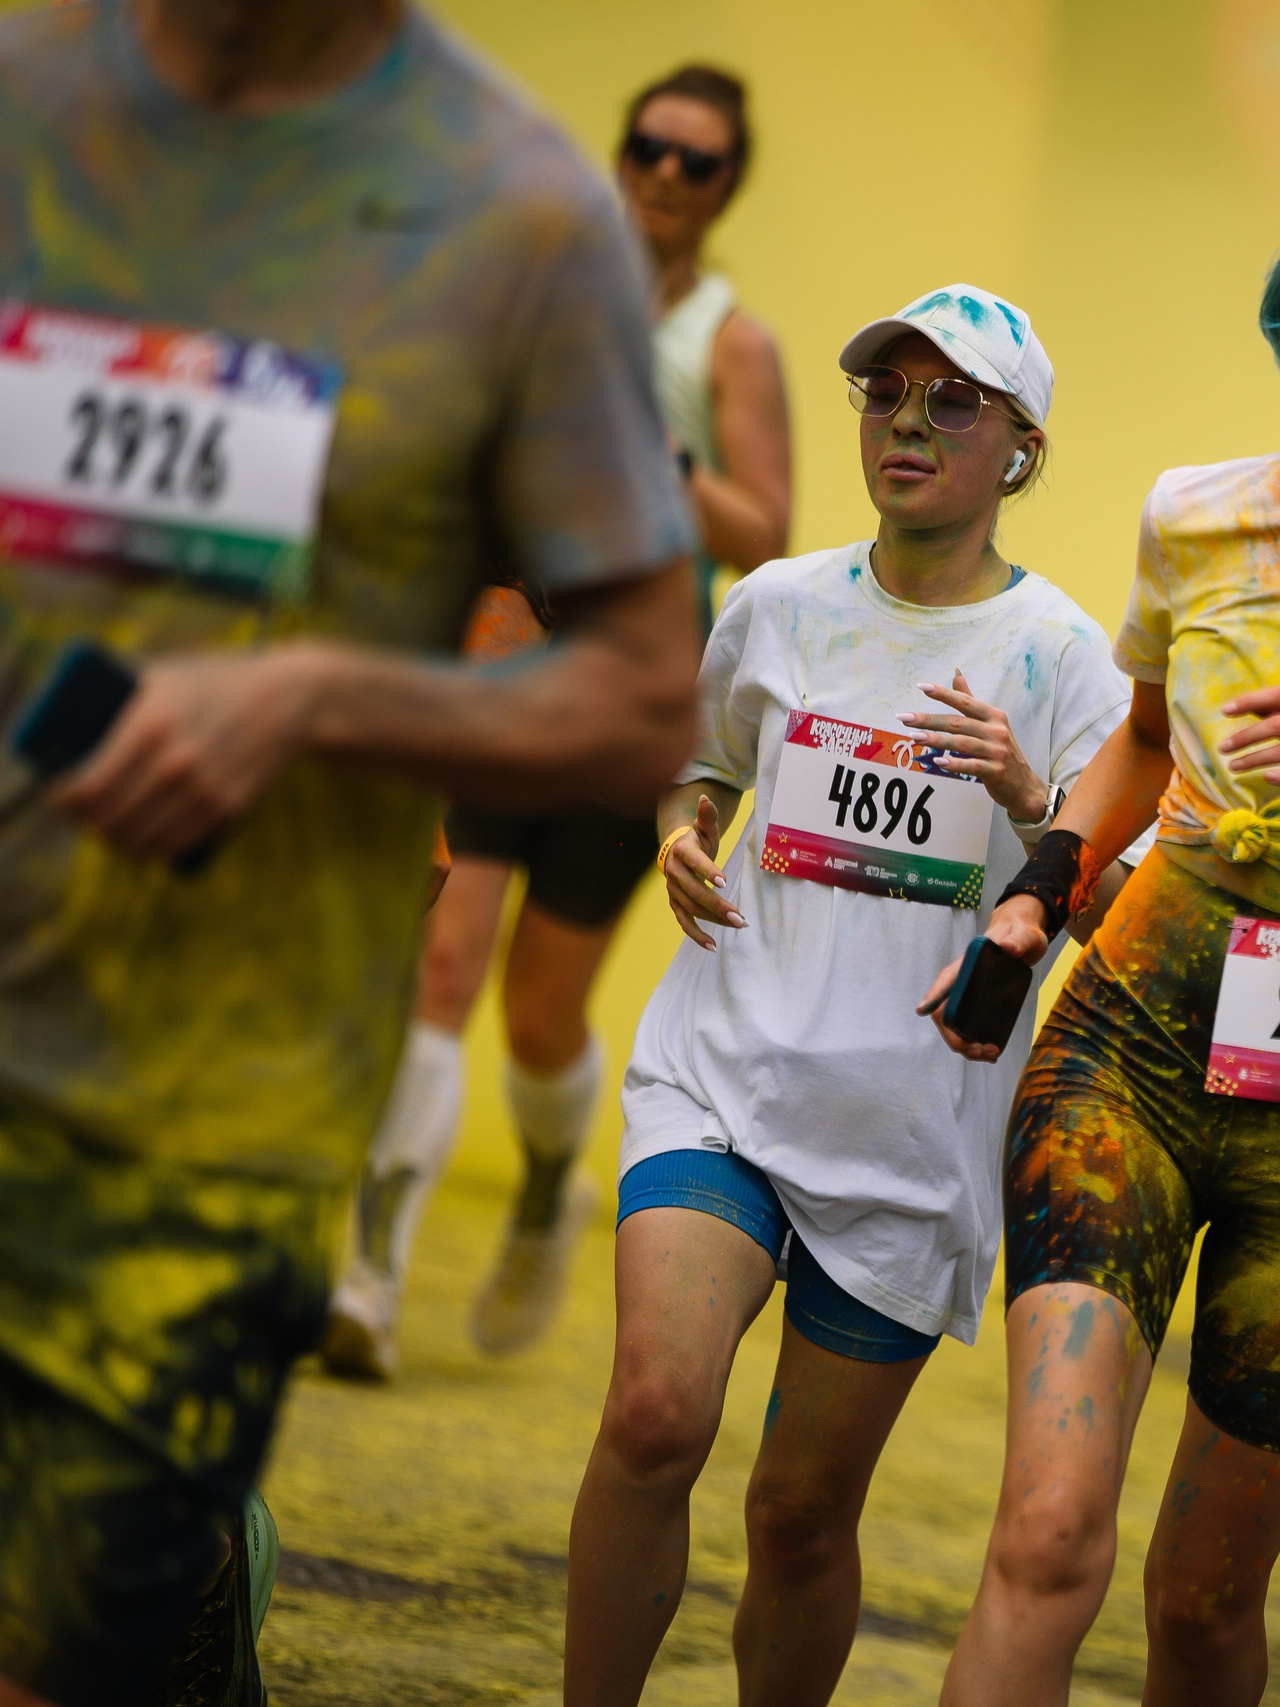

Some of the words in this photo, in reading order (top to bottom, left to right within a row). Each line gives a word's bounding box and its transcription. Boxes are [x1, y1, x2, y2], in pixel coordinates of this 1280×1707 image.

[65, 391, 230, 505] 2926
[810, 717, 874, 747] КРАСОЧНЫЙ
[819, 732, 861, 759] ЗАБЕГ
[828, 763, 936, 846] 4896
